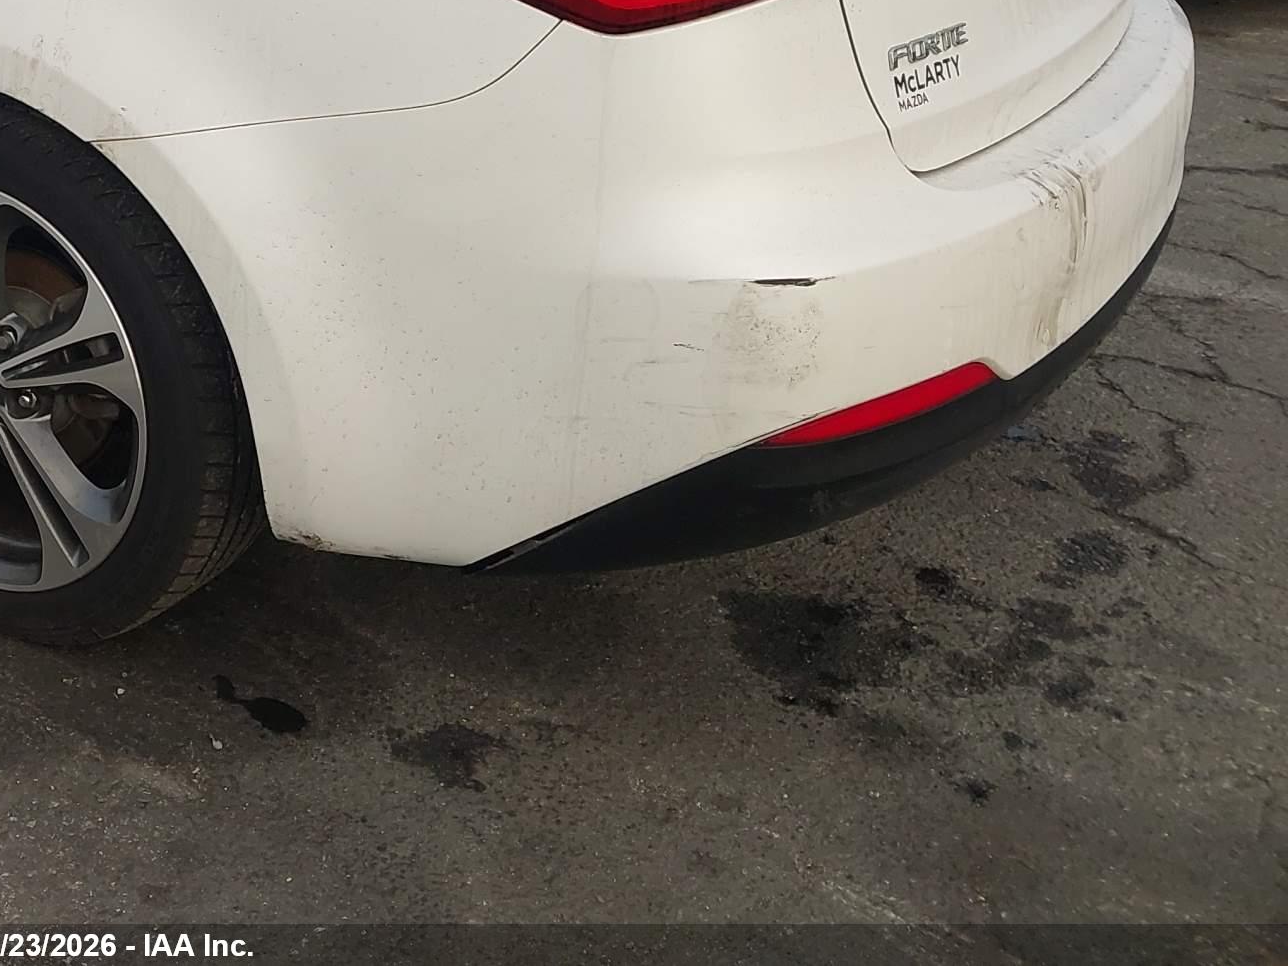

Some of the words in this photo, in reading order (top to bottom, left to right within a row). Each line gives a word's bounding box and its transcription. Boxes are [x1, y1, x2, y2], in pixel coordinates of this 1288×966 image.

[888, 22, 969, 71] FORTE
[893, 54, 961, 98] McLARTY
[898, 92, 929, 113] MAZDA
